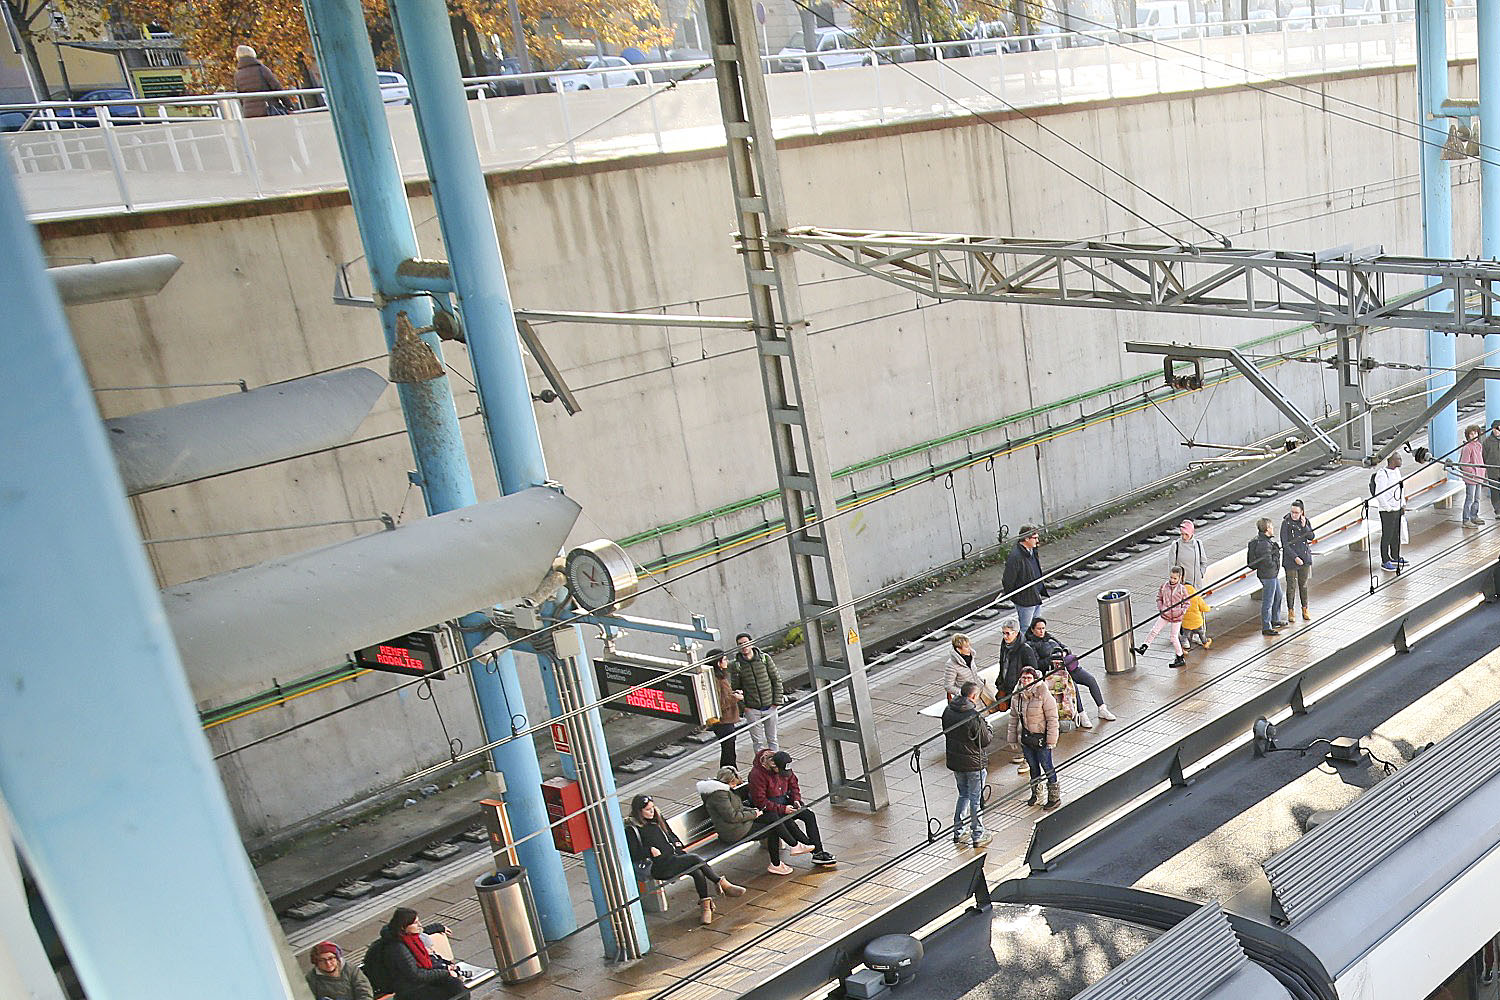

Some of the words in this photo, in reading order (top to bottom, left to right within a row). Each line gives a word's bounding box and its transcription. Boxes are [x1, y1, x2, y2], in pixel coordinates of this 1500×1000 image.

[379, 645, 408, 658] RENFE
[377, 654, 424, 670] RODALIES
[626, 694, 680, 714] RODALIES
